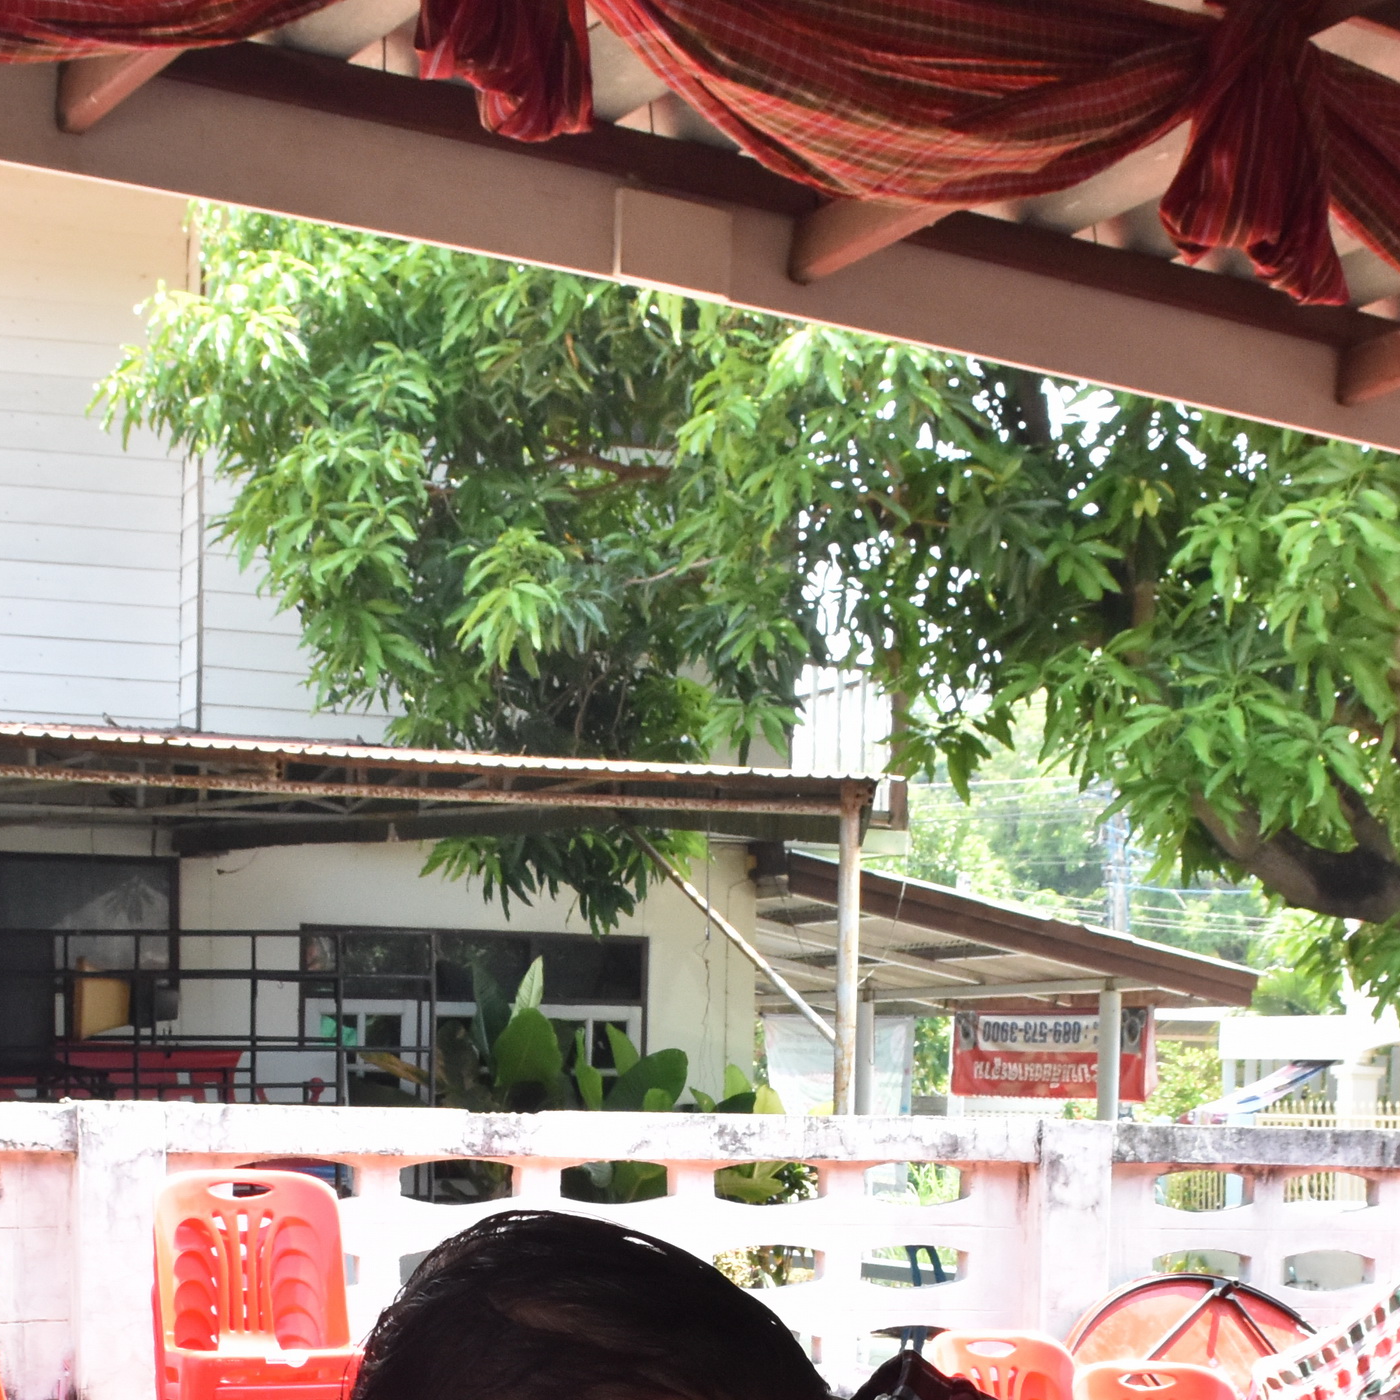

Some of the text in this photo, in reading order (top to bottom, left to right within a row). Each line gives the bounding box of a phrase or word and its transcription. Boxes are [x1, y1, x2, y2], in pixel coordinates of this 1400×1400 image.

[982, 1021, 1082, 1044] 089-573-3900
[973, 1057, 1098, 1089] ะบบเสียงมาตรฐาน
